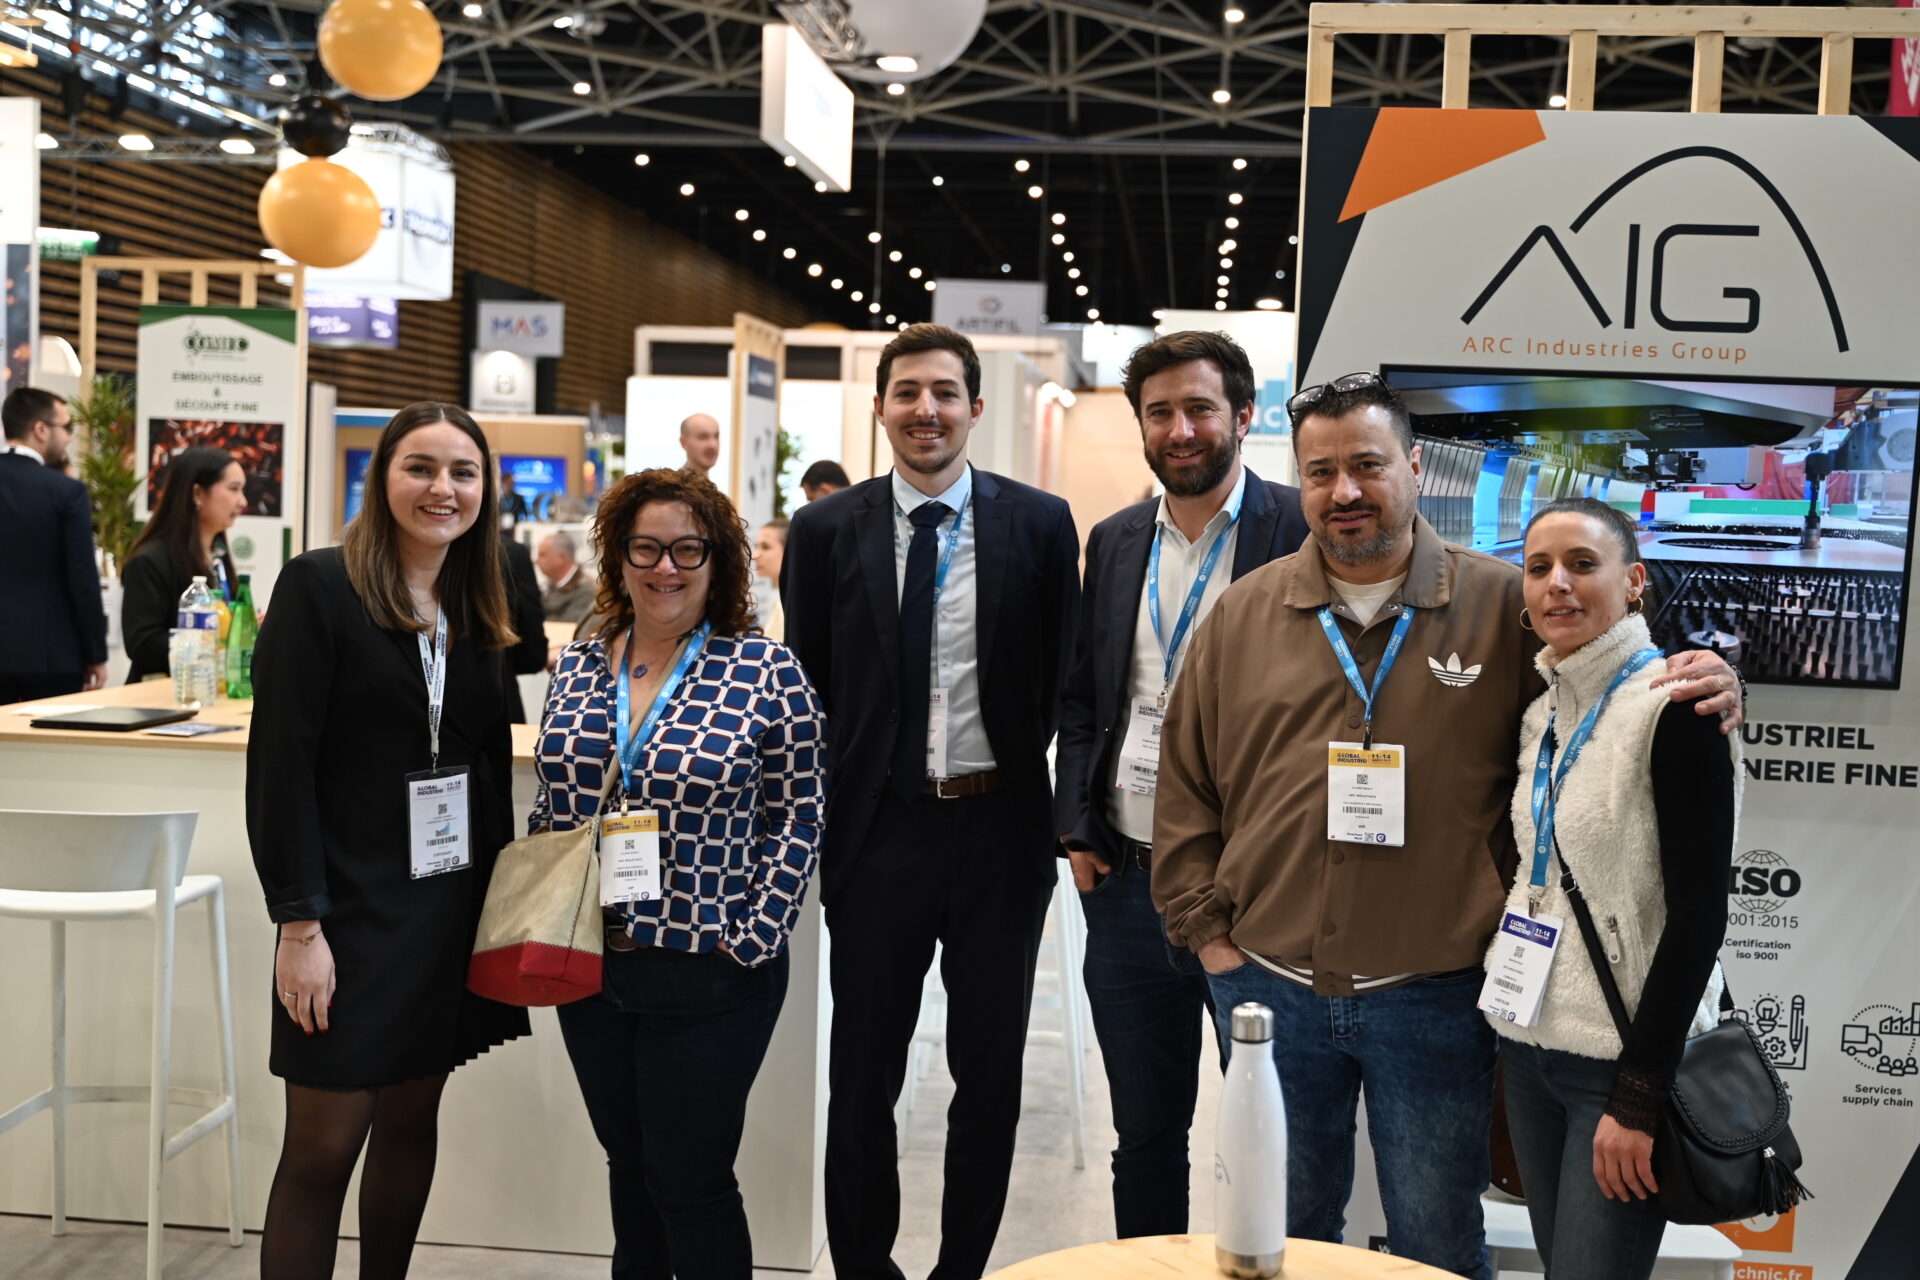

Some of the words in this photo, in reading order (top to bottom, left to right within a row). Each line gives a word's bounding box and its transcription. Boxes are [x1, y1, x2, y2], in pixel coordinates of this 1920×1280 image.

[490, 315, 549, 337] MAS
[1462, 335, 1513, 354] ARC
[1526, 337, 1658, 359] Industries
[1671, 341, 1748, 365] Group
[1742, 722, 1875, 750] USTRIEL
[1744, 758, 1835, 784] NERIE
[1845, 763, 1919, 788] FINE
[1728, 866, 1801, 898] ISO
[1727, 912, 1799, 929] 001:2015
[1724, 937, 1792, 950] Certification
[1736, 950, 1752, 959] iso
[1754, 951, 1779, 960] 9001
[1855, 1084, 1903, 1096] Services
[1842, 1095, 1881, 1107] supply
[1883, 1096, 1914, 1107] chain
[1732, 1266, 1804, 1280] chnic.fr
